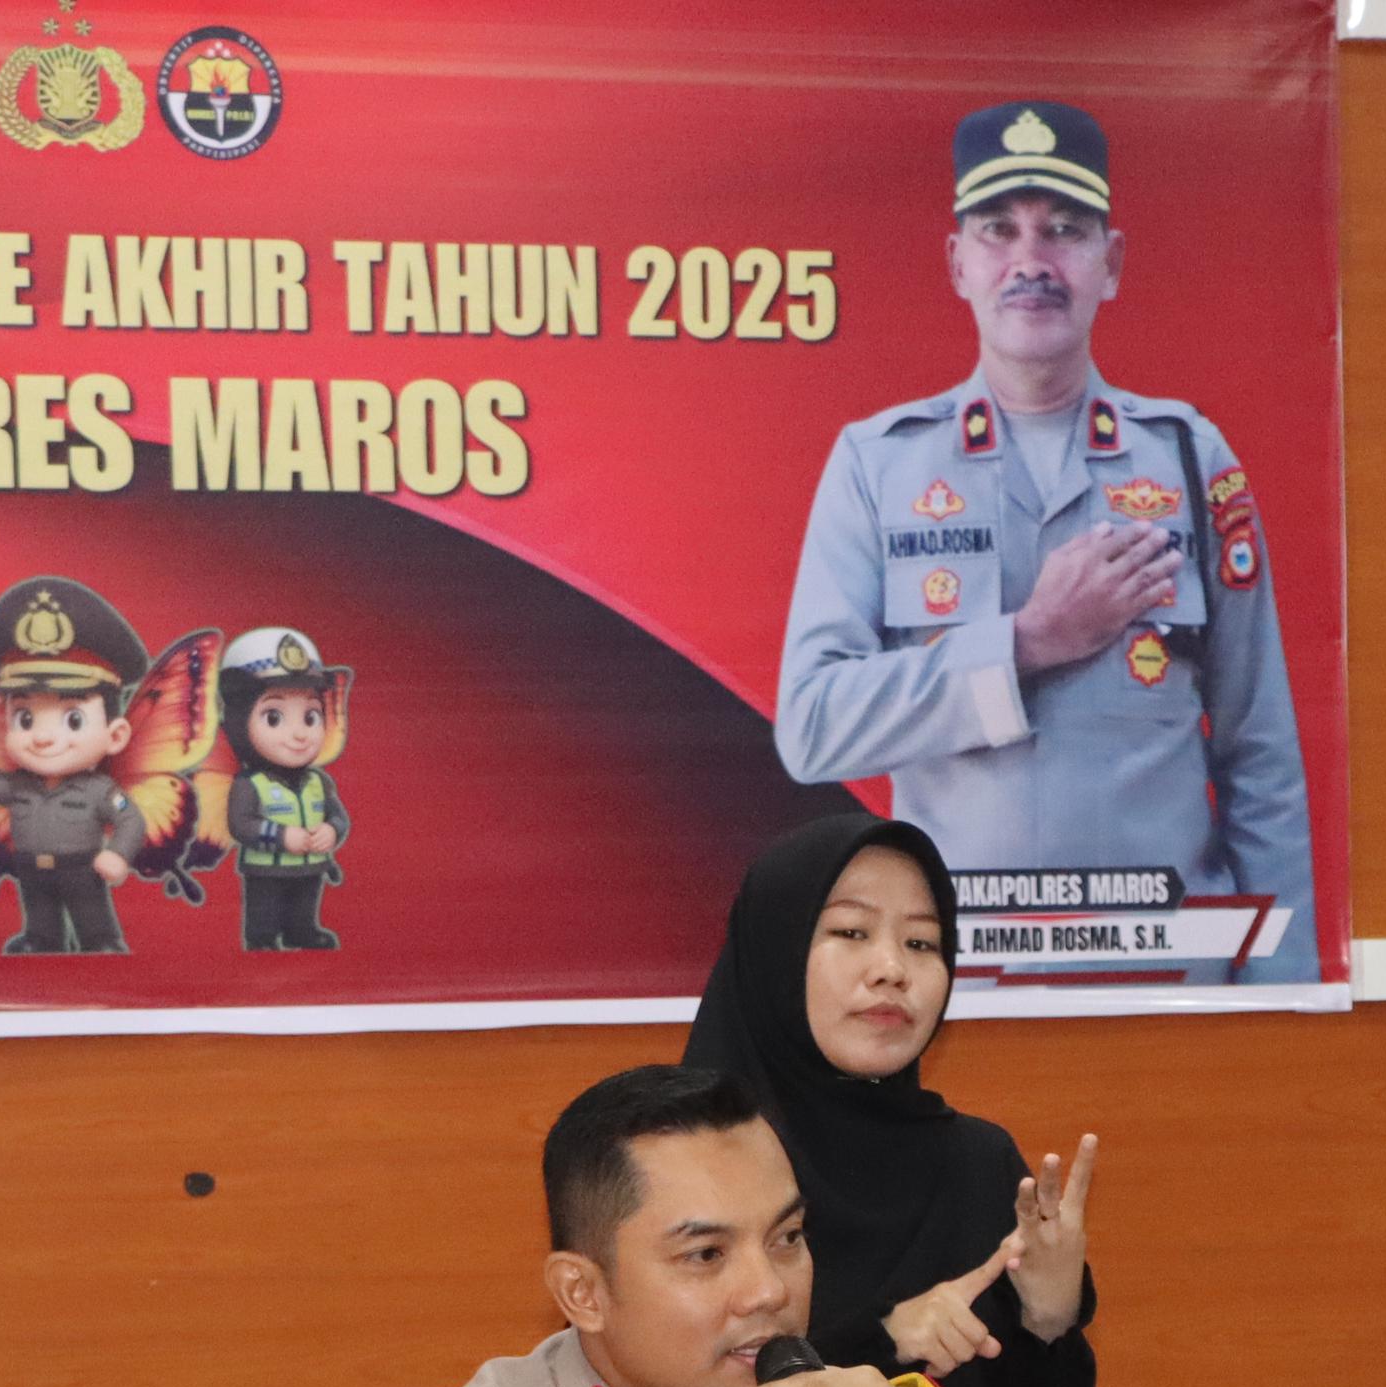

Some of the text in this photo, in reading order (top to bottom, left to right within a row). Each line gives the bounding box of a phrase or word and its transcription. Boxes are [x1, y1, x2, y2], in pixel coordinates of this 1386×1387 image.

[62, 233, 308, 331] AKHIR
[333, 240, 598, 337] TAHUN
[626, 245, 837, 342] 2025
[170, 376, 529, 496] MAROS
[1088, 872, 1170, 905] MAROS
[973, 926, 1043, 953] AHMAD
[1051, 924, 1128, 953] ROSMA,
[1134, 923, 1172, 950] S.H.
